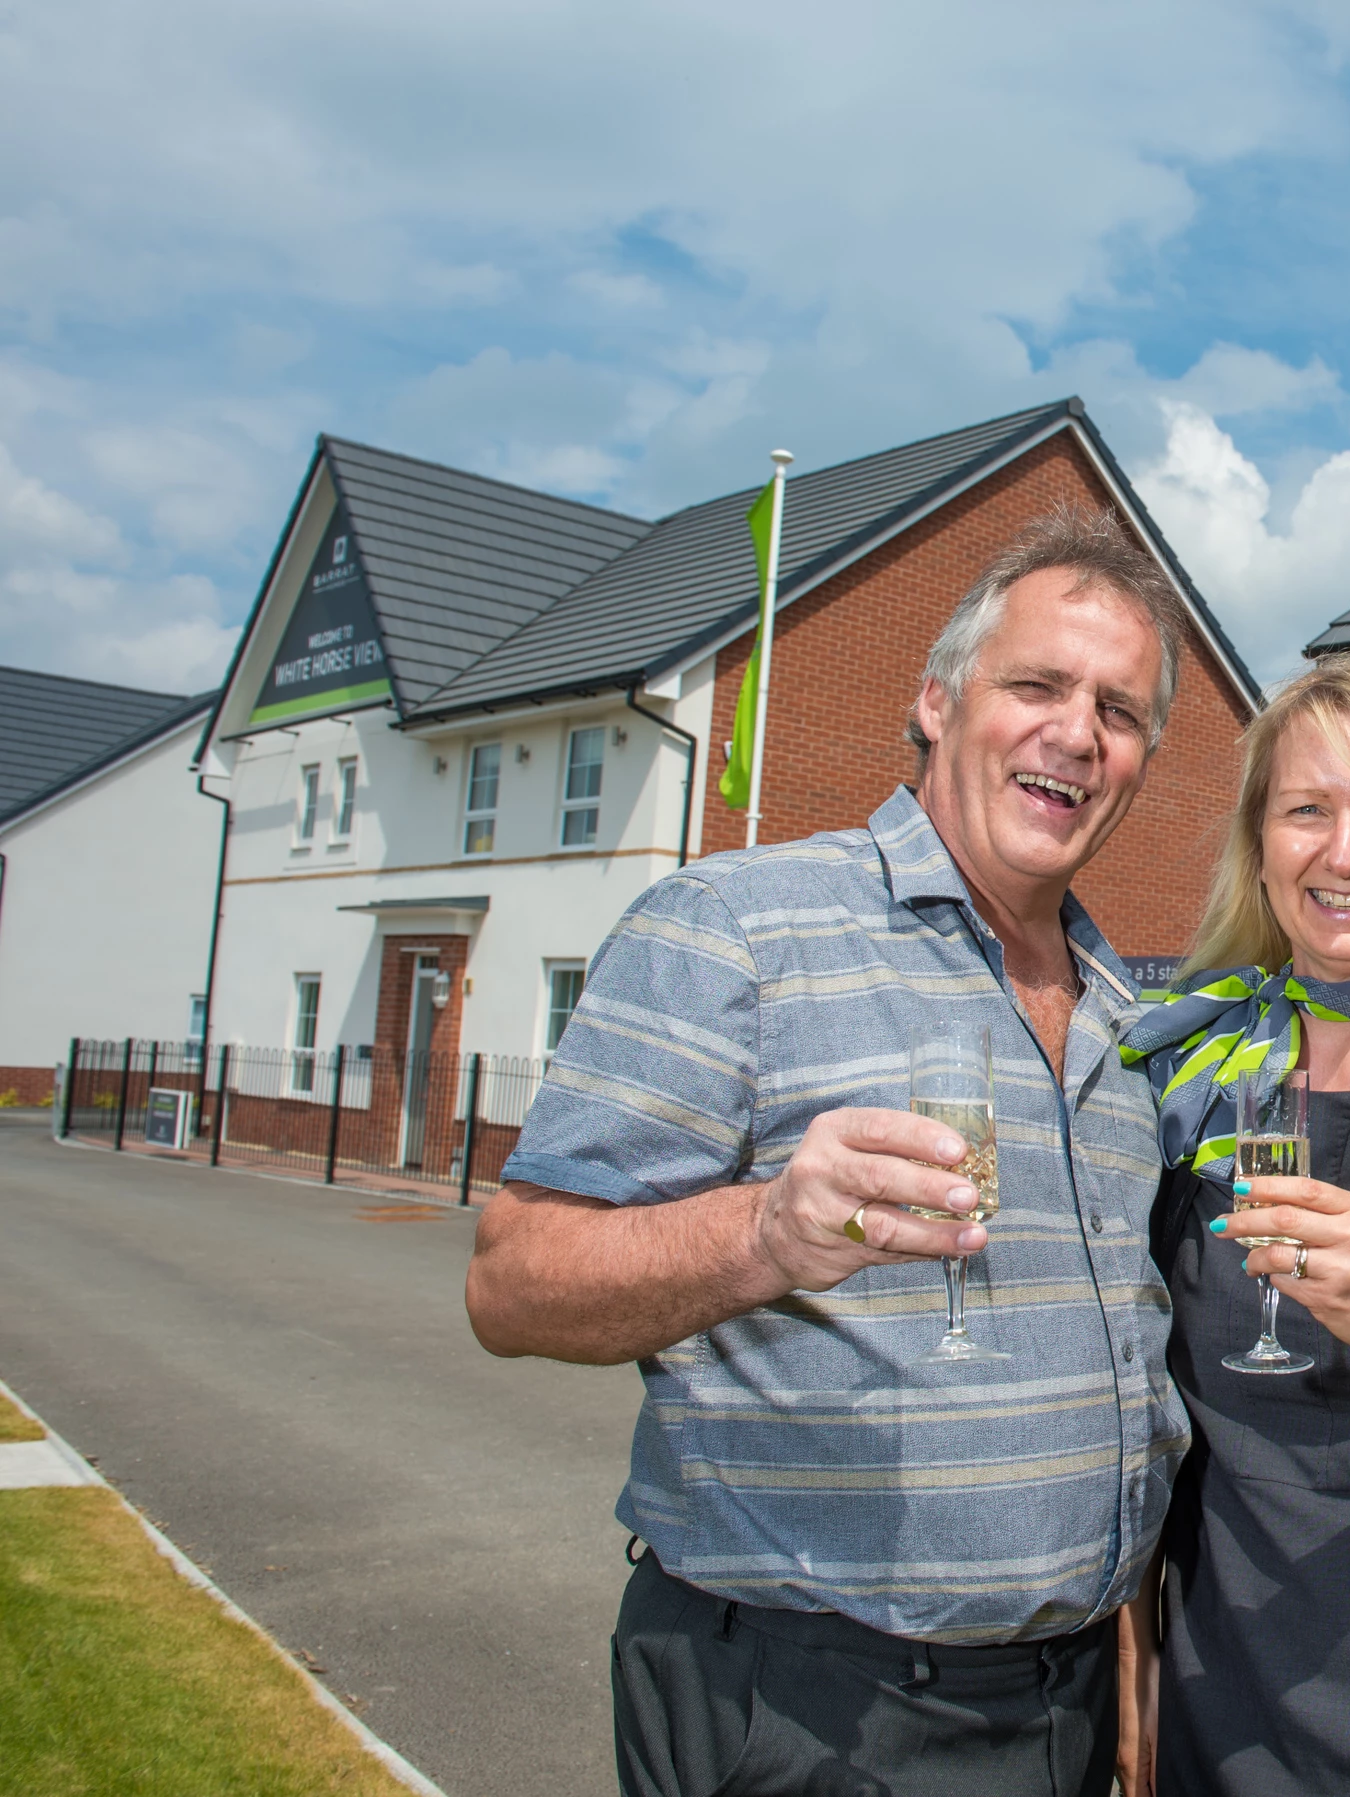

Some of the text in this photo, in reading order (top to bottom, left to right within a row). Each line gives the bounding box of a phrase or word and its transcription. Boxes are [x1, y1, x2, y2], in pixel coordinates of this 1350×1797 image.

[313, 562, 356, 588] BARRAT
[308, 624, 354, 649] WELCOME TO
[275, 656, 311, 688] WHITE
[312, 646, 352, 677] HORSE
[1135, 967, 1143, 981] a
[1147, 963, 1155, 981] 5
[1158, 965, 1179, 981] sta
